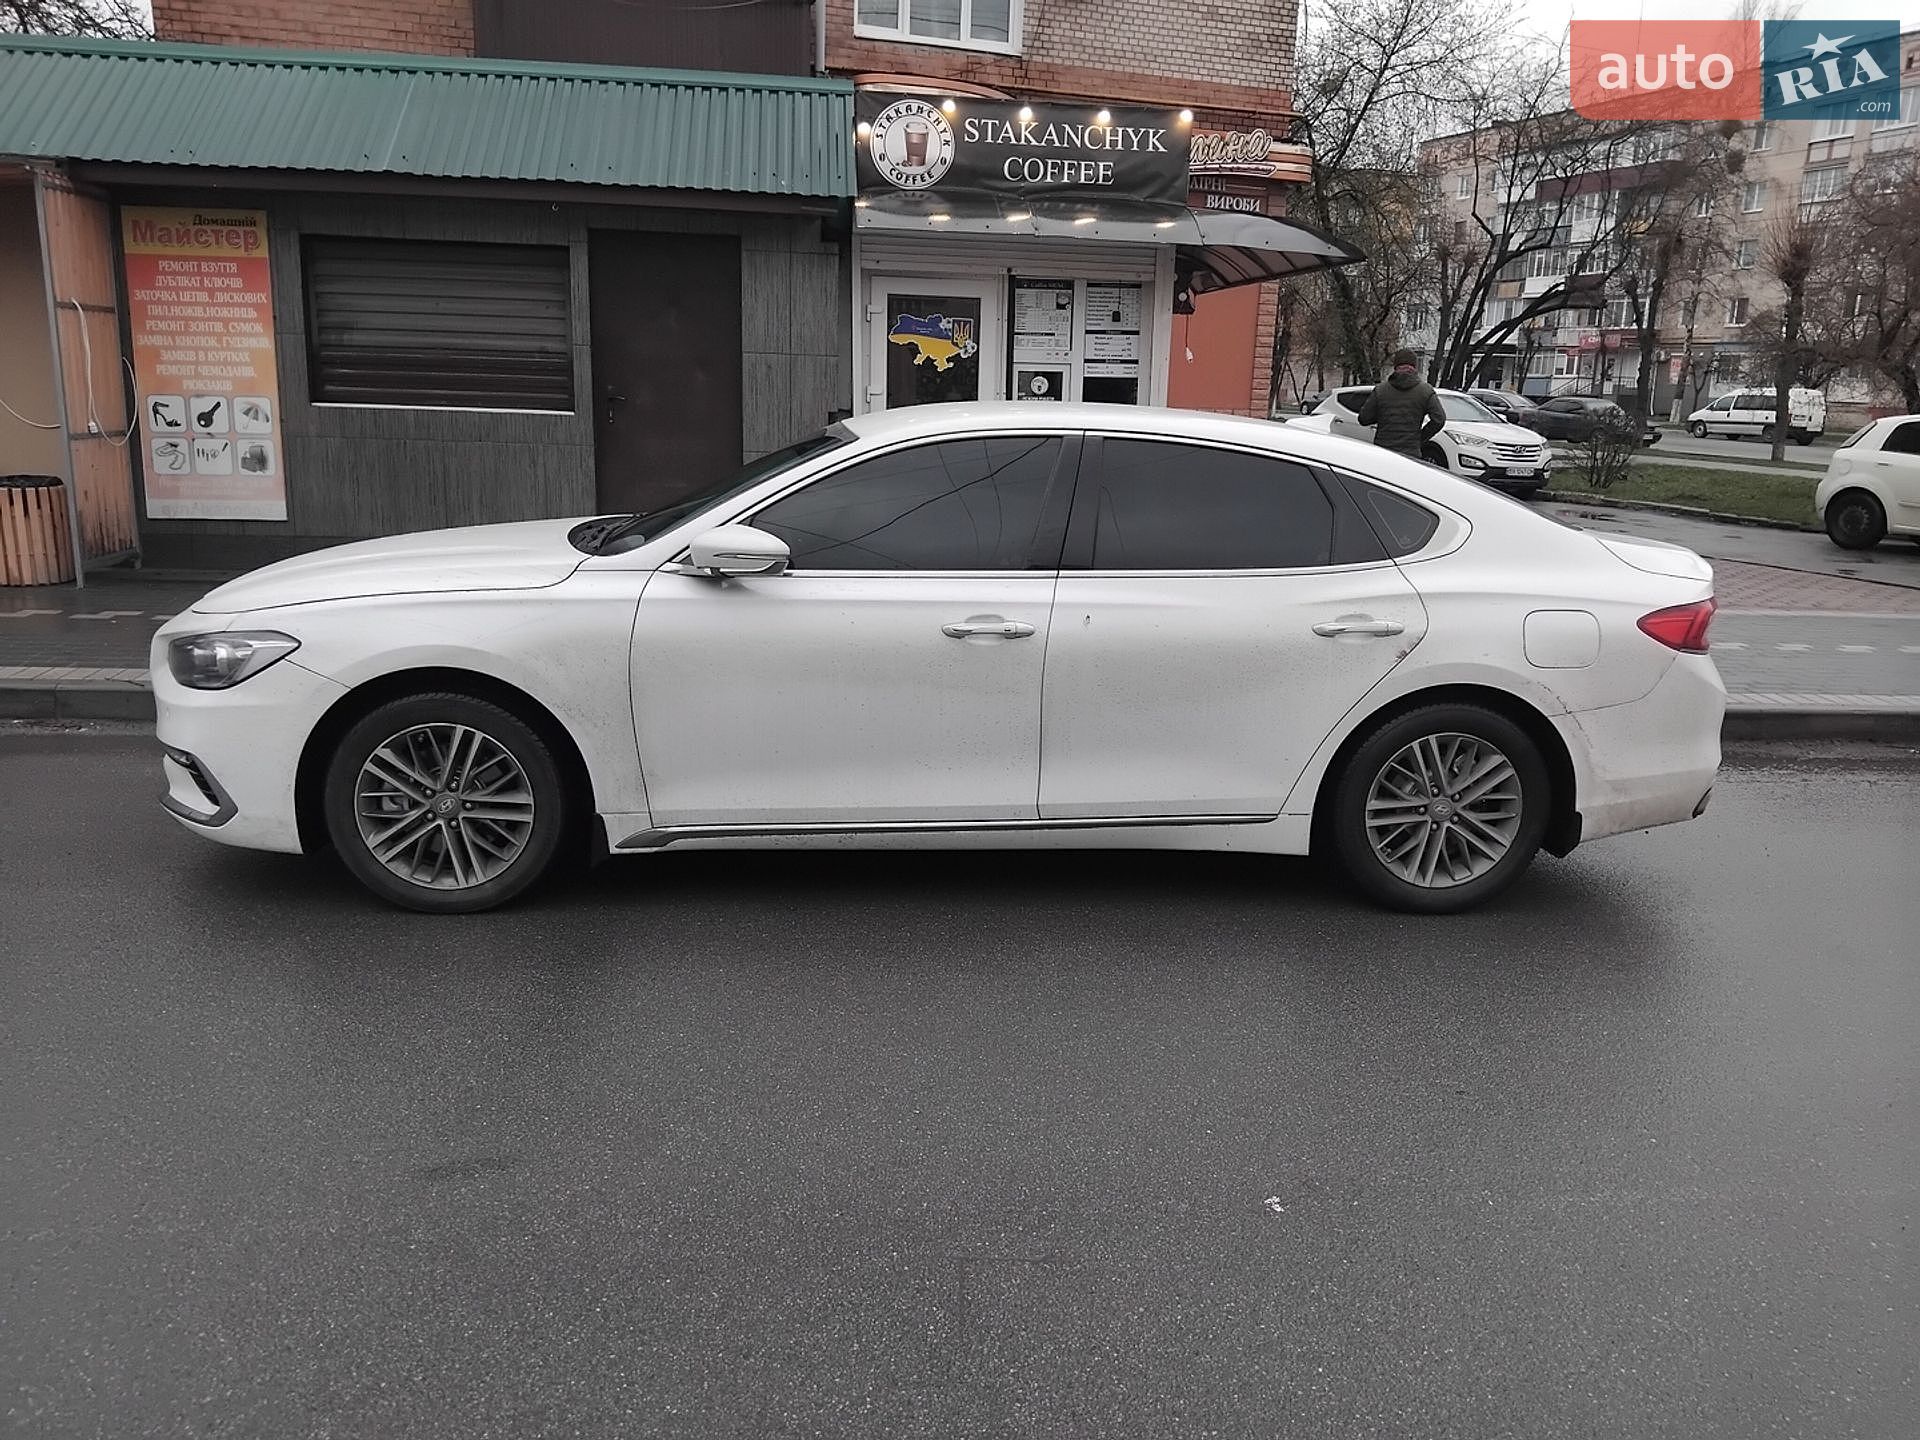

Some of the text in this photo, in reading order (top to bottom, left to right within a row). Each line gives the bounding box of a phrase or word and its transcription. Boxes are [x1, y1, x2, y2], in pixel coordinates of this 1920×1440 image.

[875, 104, 951, 147] STAKANCHYK
[964, 118, 1168, 152] STAKANCHYK
[889, 167, 935, 185] COFFEE
[1003, 156, 1115, 185] COFFEE
[1206, 194, 1261, 212] ВИРОБИ
[192, 214, 256, 227] Домашній
[131, 218, 260, 254] Майстер
[158, 260, 238, 273] РЕМОНТ ВЗУТТЯ
[155, 275, 243, 288] ДУБЛІКАТ КЛЮЧІВ
[134, 289, 178, 301] ЗАТОЧКА
[214, 291, 268, 303] ДИСКОВИХ
[146, 320, 185, 331] РЕМОНТ
[228, 322, 263, 333] СУМОК
[137, 335, 174, 345] ЗАМІНА
[160, 350, 196, 360] ЗАМКІВ
[207, 351, 251, 362] КУРТКАХ
[156, 364, 197, 376] РЕМОНТ
